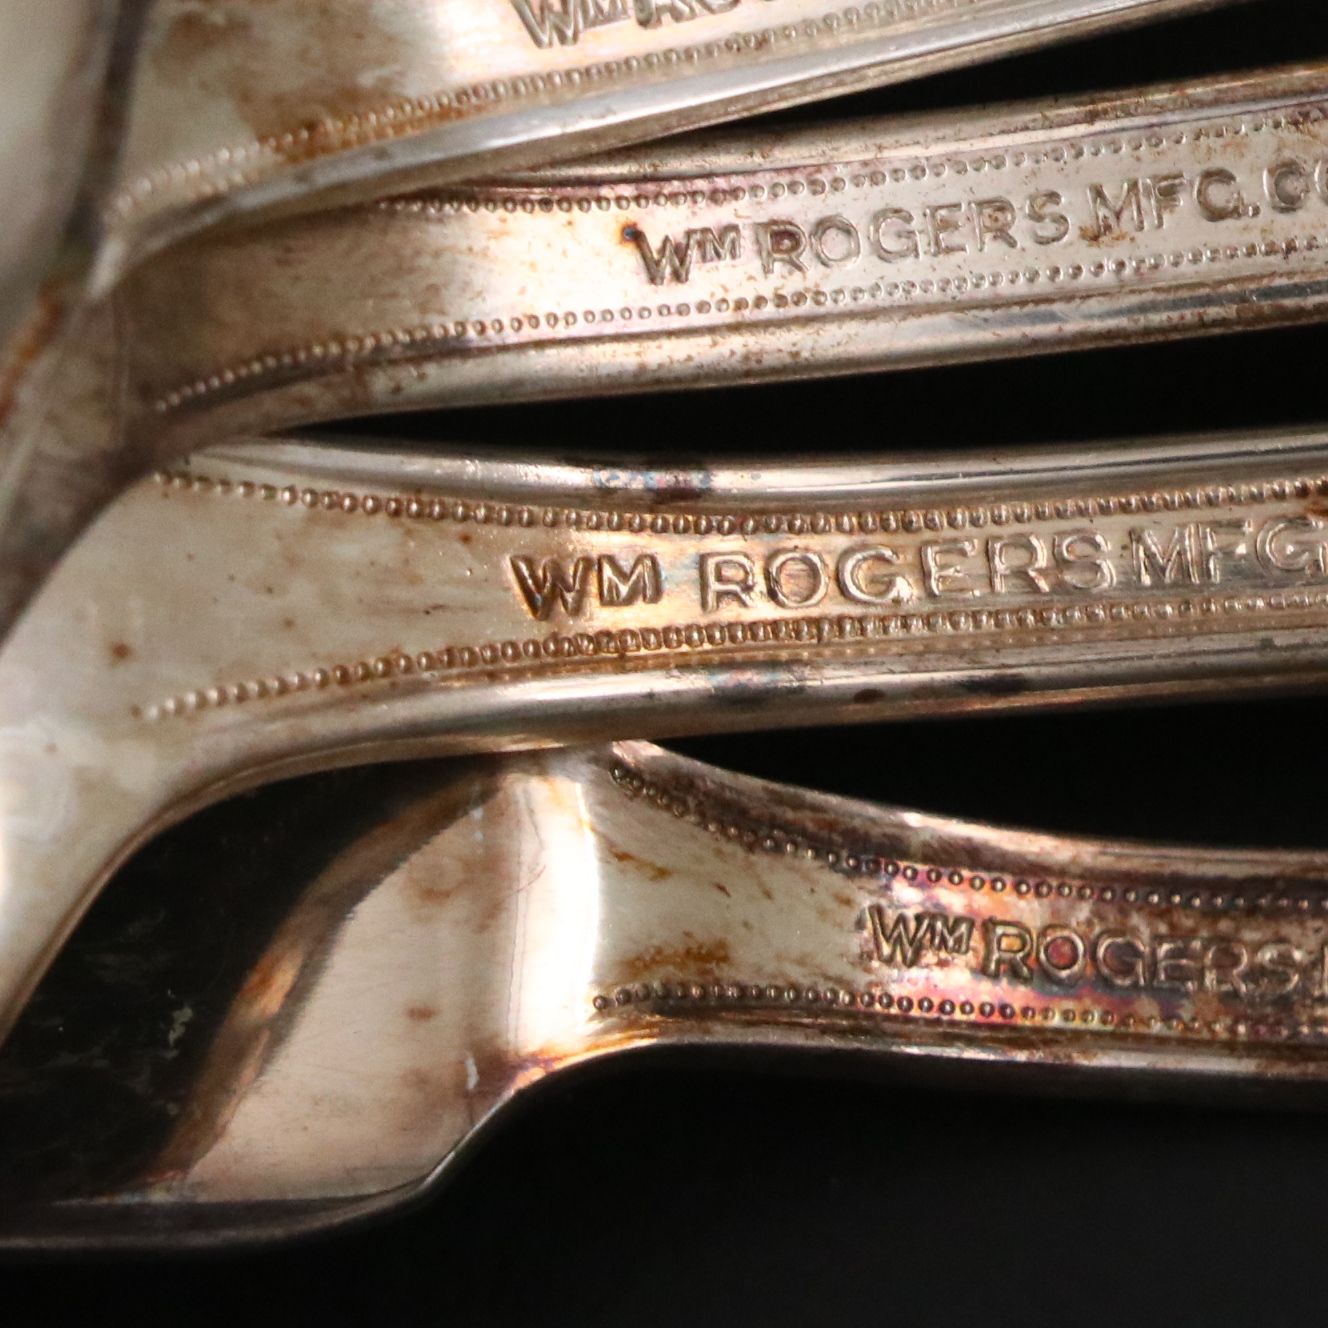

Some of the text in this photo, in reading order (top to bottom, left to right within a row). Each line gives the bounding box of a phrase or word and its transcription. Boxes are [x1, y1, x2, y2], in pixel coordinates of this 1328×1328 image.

[749, 190, 1073, 276] ROGERS
[509, 550, 663, 622] WM
[698, 528, 1118, 616] ROGERS
[975, 923, 1306, 995] ROGERS
